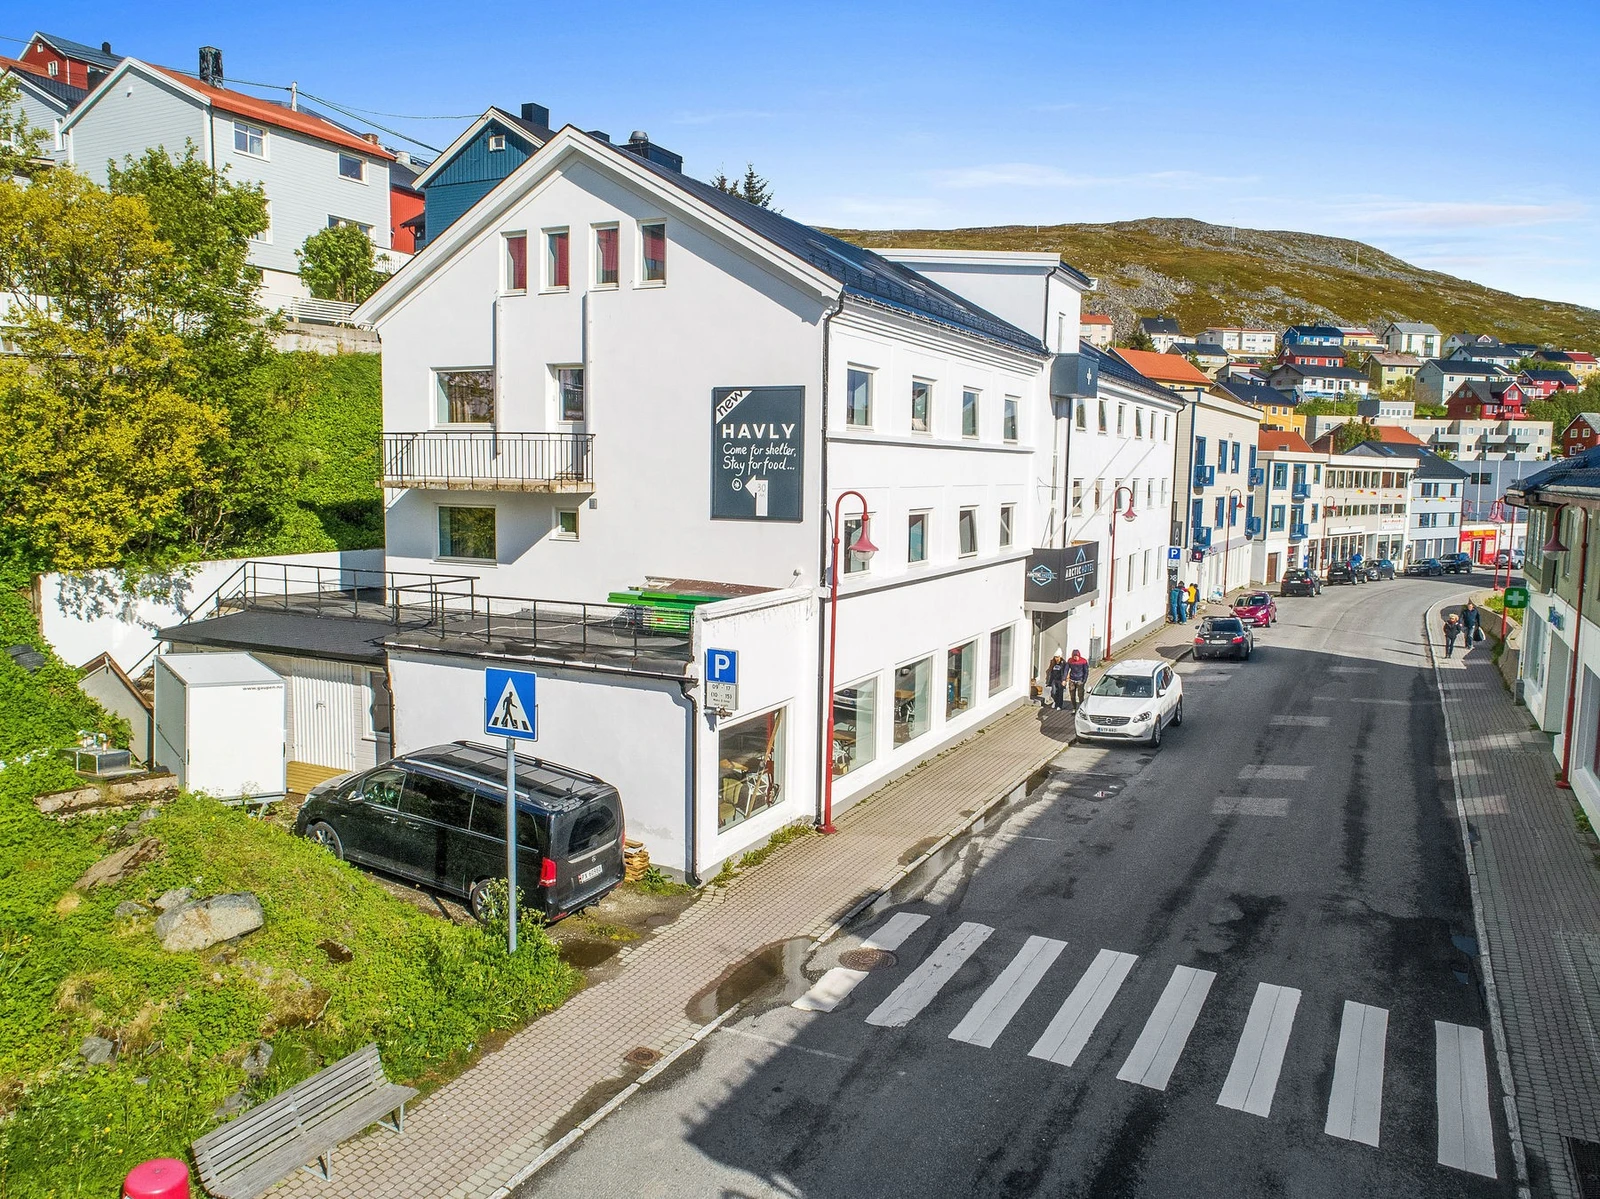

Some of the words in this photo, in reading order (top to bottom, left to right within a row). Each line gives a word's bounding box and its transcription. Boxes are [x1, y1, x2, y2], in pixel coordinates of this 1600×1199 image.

[717, 390, 743, 417] new
[722, 423, 796, 439] HAVLY
[722, 442, 748, 455] Come
[749, 443, 764, 460] for
[765, 442, 797, 457] shelter,
[722, 455, 746, 476] Stay
[747, 457, 763, 475] for
[763, 457, 795, 475] food...
[1171, 549, 1178, 558] P
[1065, 565, 1082, 578] ARCTIC
[714, 653, 730, 679] P
